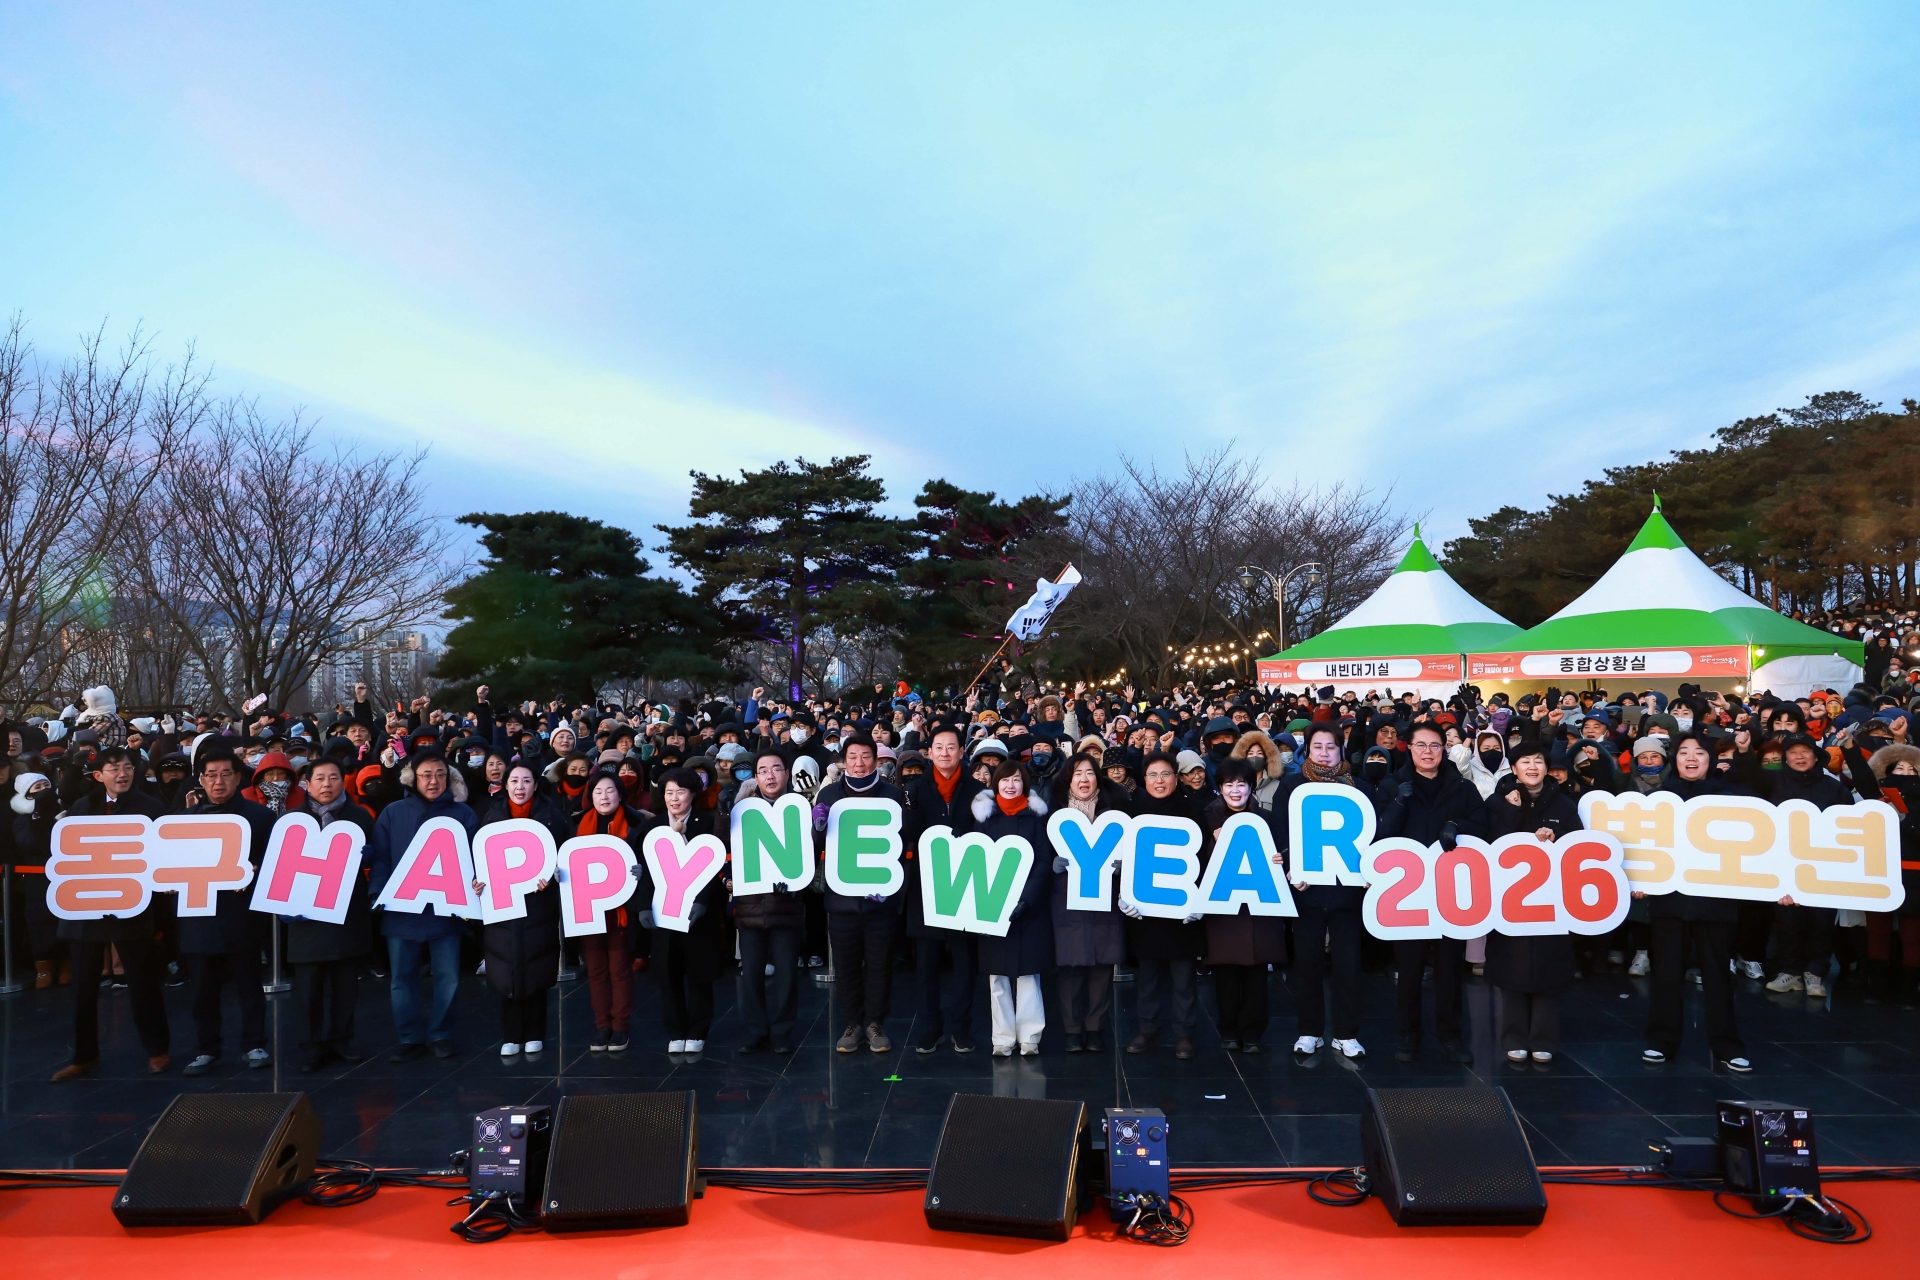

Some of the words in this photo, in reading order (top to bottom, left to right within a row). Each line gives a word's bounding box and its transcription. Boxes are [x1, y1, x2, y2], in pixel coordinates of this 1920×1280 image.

[1326, 662, 1389, 677] 내빈대기실
[1560, 655, 1646, 673] 종합상황실
[53, 821, 247, 913] 동구
[266, 823, 716, 925] HAPPY
[740, 803, 1023, 924] NEW
[1057, 793, 1366, 908] YEAR
[1372, 841, 1619, 928] 2026
[1590, 800, 1892, 900] 병오년
